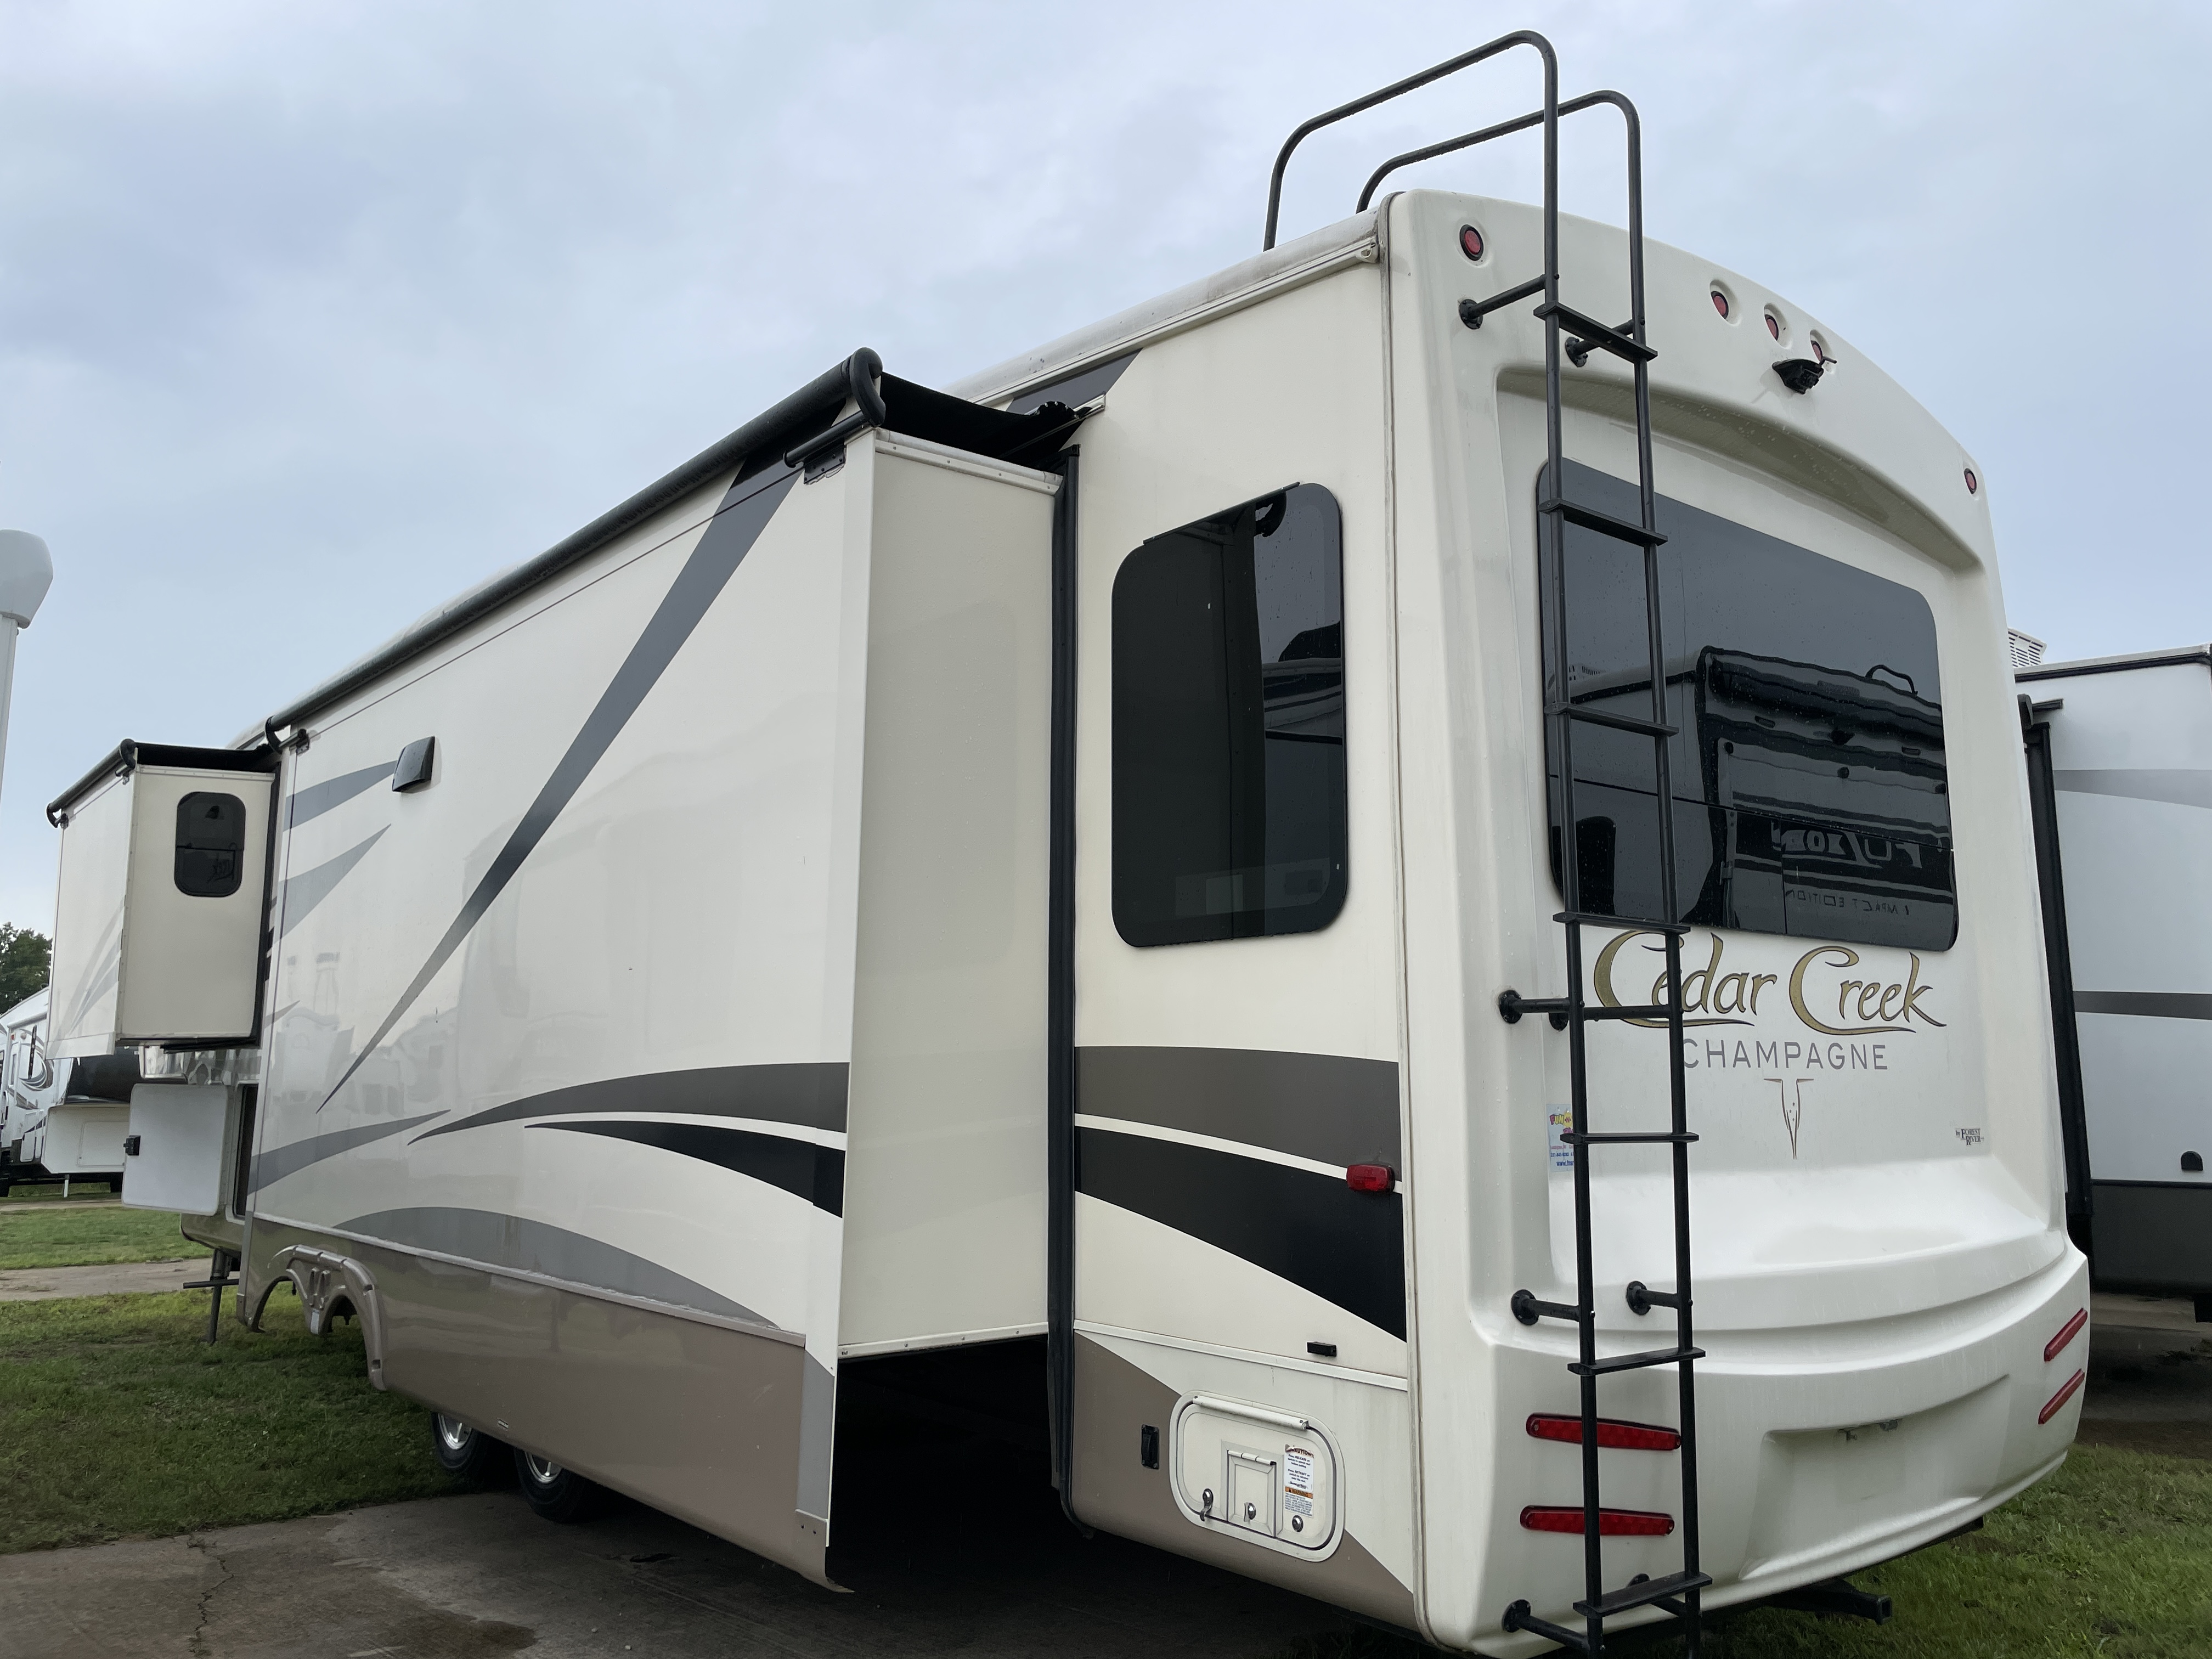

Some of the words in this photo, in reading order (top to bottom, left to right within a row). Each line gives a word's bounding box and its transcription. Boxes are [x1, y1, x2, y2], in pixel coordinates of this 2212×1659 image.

[1789, 945, 1947, 1036] Creek
[1683, 1038, 1889, 1070] CHAMPAGNE
[1961, 1128, 1980, 1140] FOREST
[1966, 1135, 1982, 1146] RIVER
